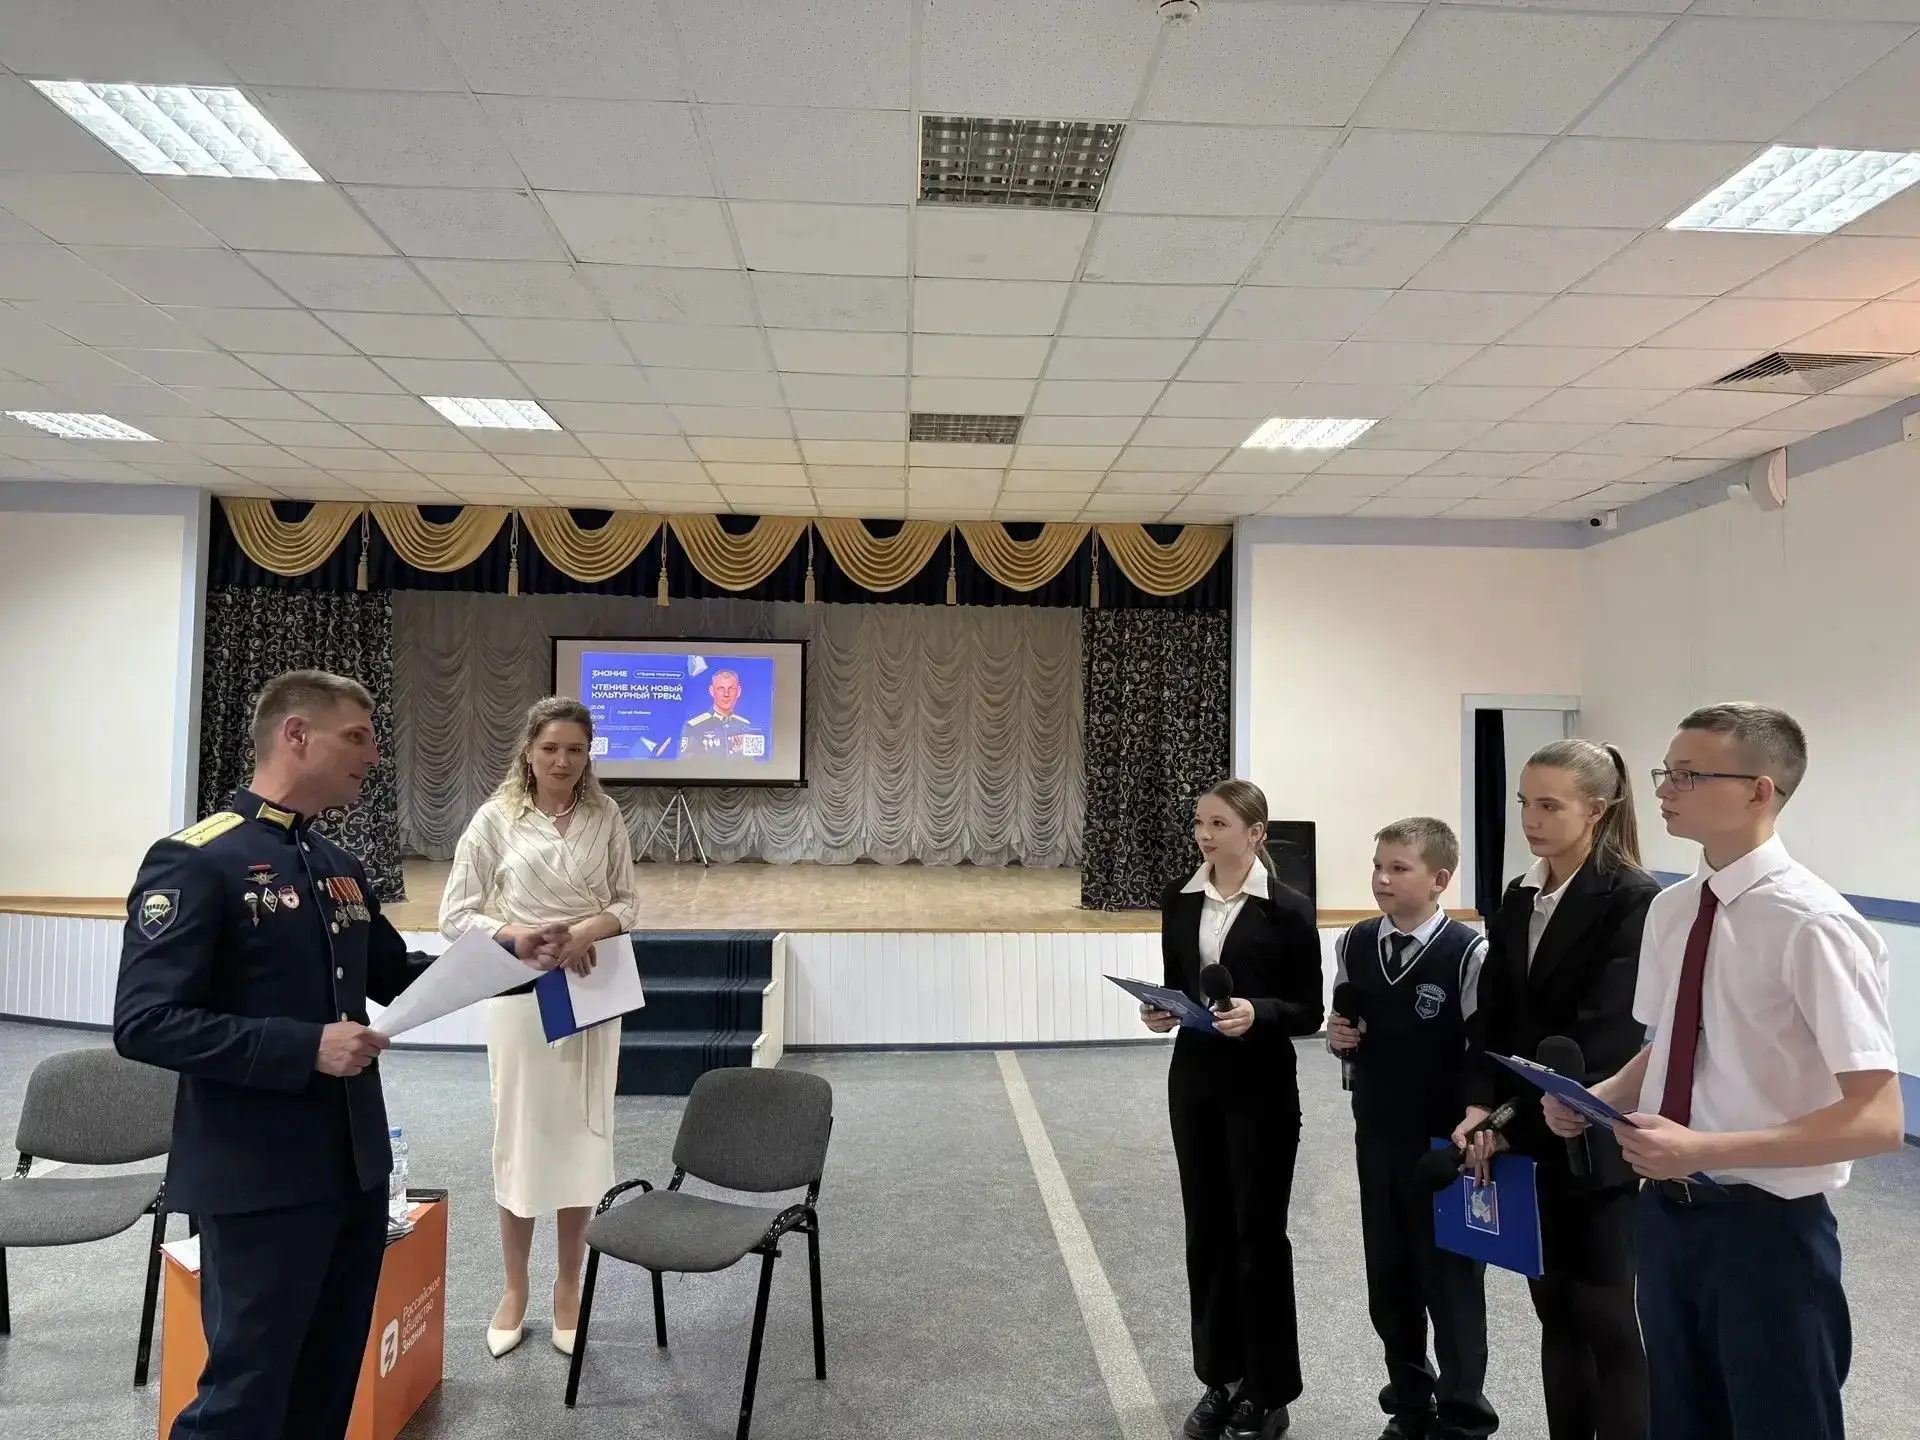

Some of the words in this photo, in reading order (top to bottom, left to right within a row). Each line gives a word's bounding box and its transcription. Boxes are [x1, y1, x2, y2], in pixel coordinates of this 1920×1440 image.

[592, 691, 650, 699] КУЛЬТУРНЫЙ
[653, 692, 682, 700] ТРЕНД
[651, 684, 683, 692] НОВЫЙ
[402, 1276, 440, 1321] Российское
[402, 1299, 433, 1339] общество
[402, 1321, 426, 1355] Знание
